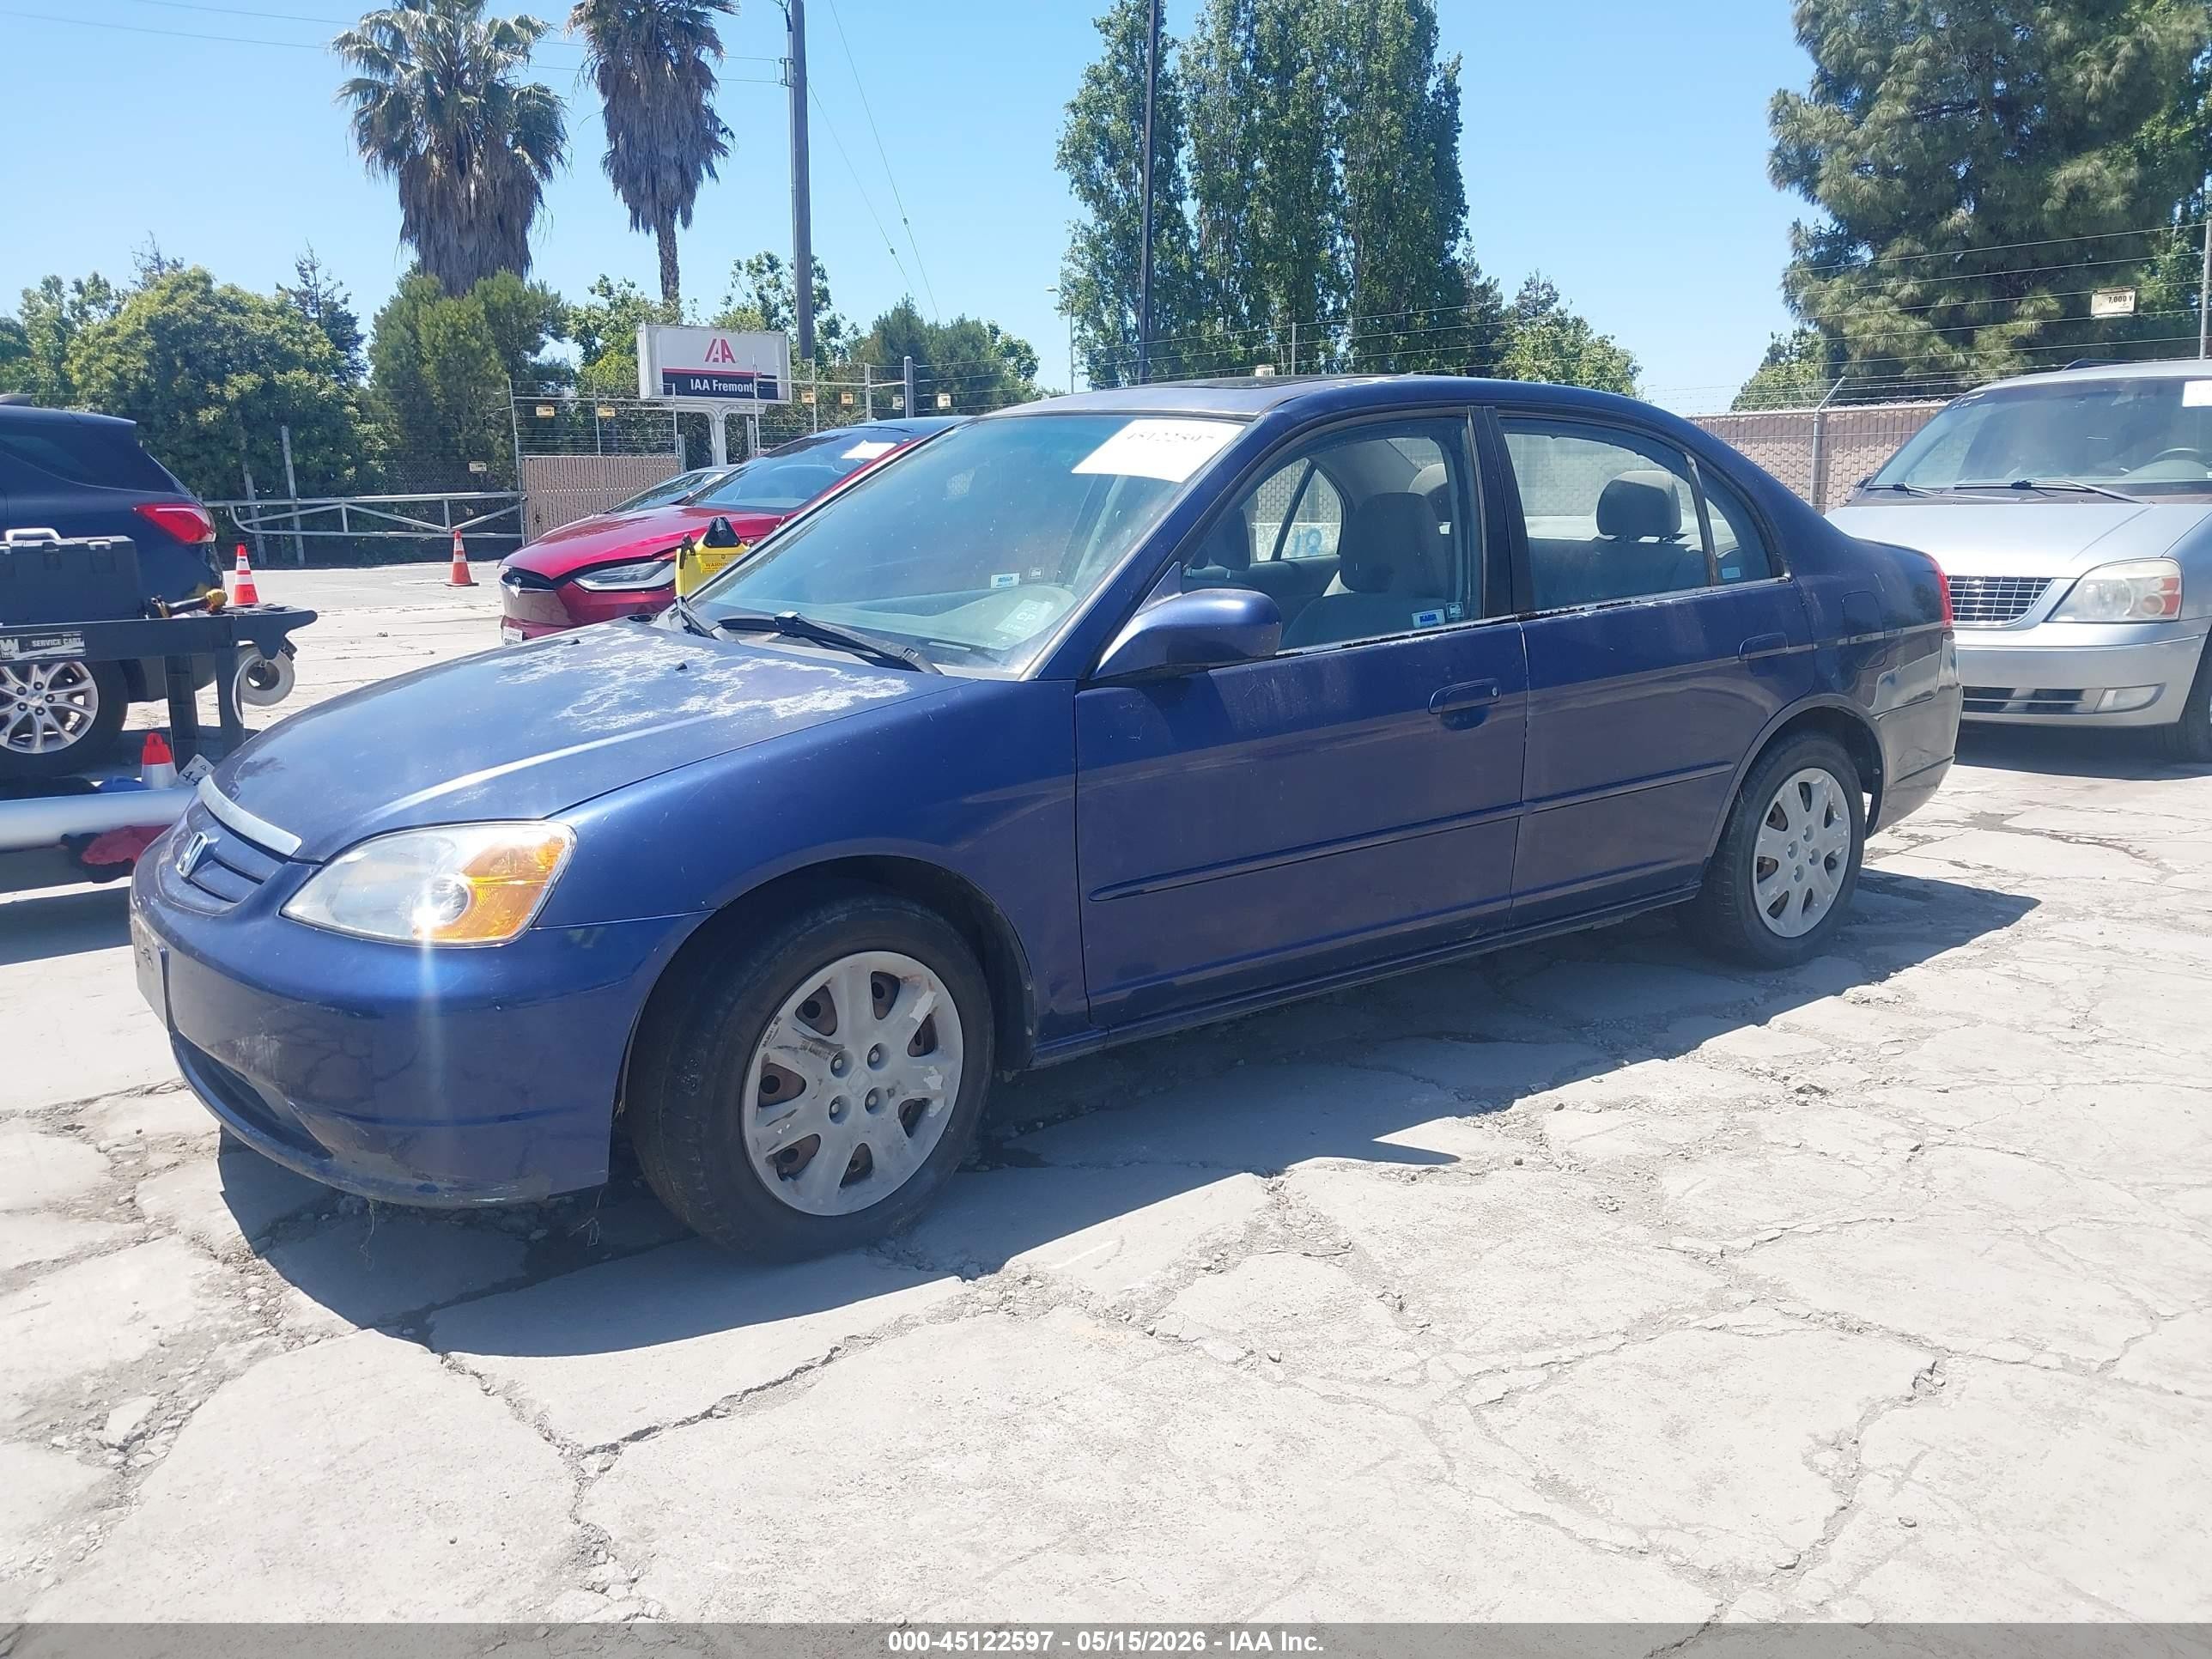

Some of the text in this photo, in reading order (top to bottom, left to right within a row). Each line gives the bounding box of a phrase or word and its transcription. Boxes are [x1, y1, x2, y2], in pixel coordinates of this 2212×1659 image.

[690, 379, 753, 392] IAA Fremont
[32, 638, 62, 647] SERVICE
